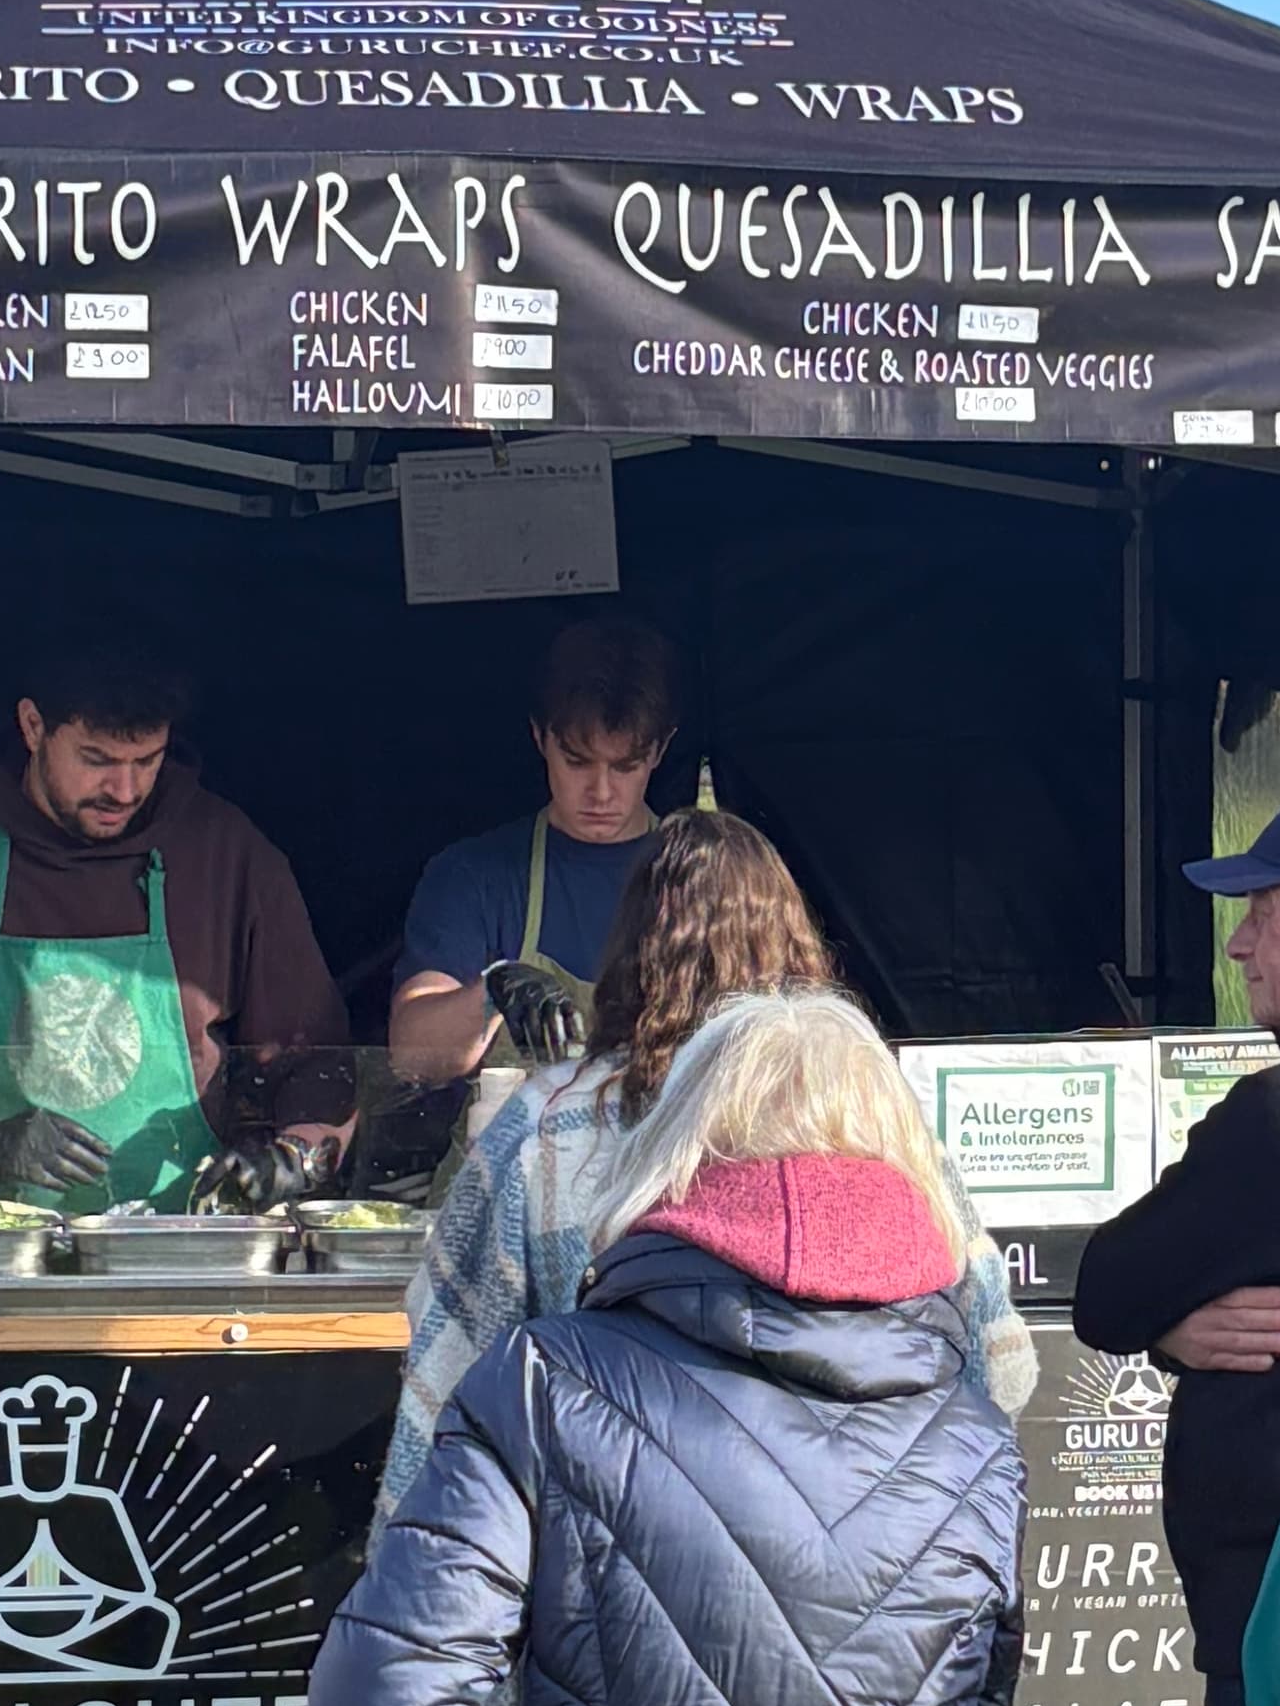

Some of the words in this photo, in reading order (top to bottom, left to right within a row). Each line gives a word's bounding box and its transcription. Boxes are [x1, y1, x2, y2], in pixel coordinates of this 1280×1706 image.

[76, 9, 243, 26] UNITED
[257, 9, 466, 26] KINGDOM
[480, 10, 536, 27] OF
[547, 13, 780, 38] GOODNESS
[104, 37, 745, 67] INFO@GURUCHEF.CO.UK
[223, 67, 706, 118] QUESADILLIA
[775, 80, 1026, 129] WRAPS
[220, 171, 527, 273] WRAPS
[613, 181, 1151, 294] QUESADILLIA
[290, 290, 429, 328] CHICKEN
[803, 300, 939, 339] CHICKEN
[292, 334, 416, 371] FALAFEL
[633, 340, 767, 379] CHEDDAR
[774, 346, 869, 384] CHEESE
[879, 351, 905, 384] &
[914, 350, 1031, 386] ROASTED
[1035, 351, 1154, 391] VEGGIES
[292, 380, 461, 418] HALLOUMI
[960, 1102, 1094, 1130] Allergens
[1065, 1422, 1138, 1449] GURU
[1076, 1484, 1129, 1502] BOOK
[1132, 1484, 1156, 1501] US
[1073, 1595, 1127, 1610] VEGAN
[1022, 1627, 1187, 1676] HICK
